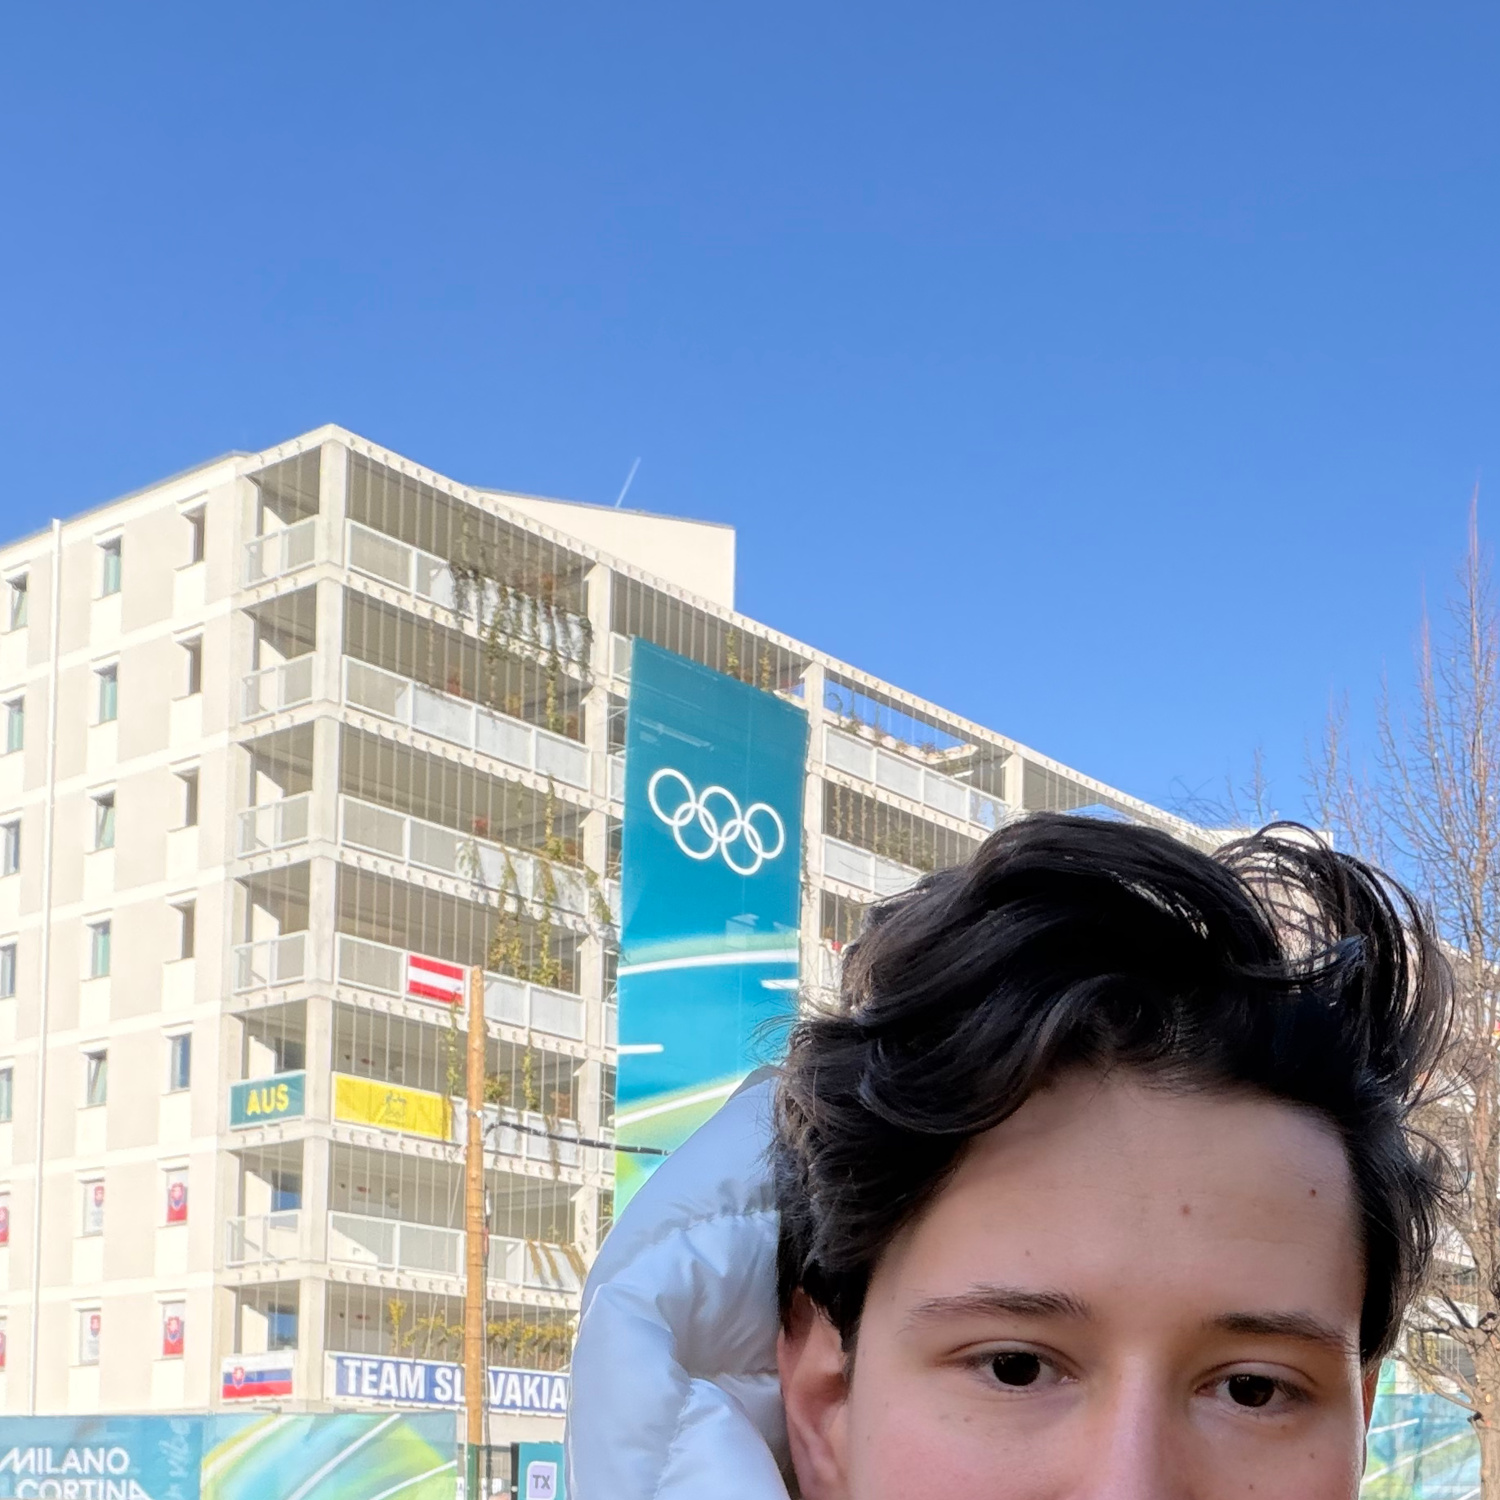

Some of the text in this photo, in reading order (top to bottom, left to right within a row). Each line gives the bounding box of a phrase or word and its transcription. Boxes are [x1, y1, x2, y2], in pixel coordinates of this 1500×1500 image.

[247, 1083, 290, 1116] AUS
[342, 1359, 567, 1411] TEAM SLVAKIA
[0, 1446, 131, 1475] MILANO
[532, 1474, 551, 1490] TX
